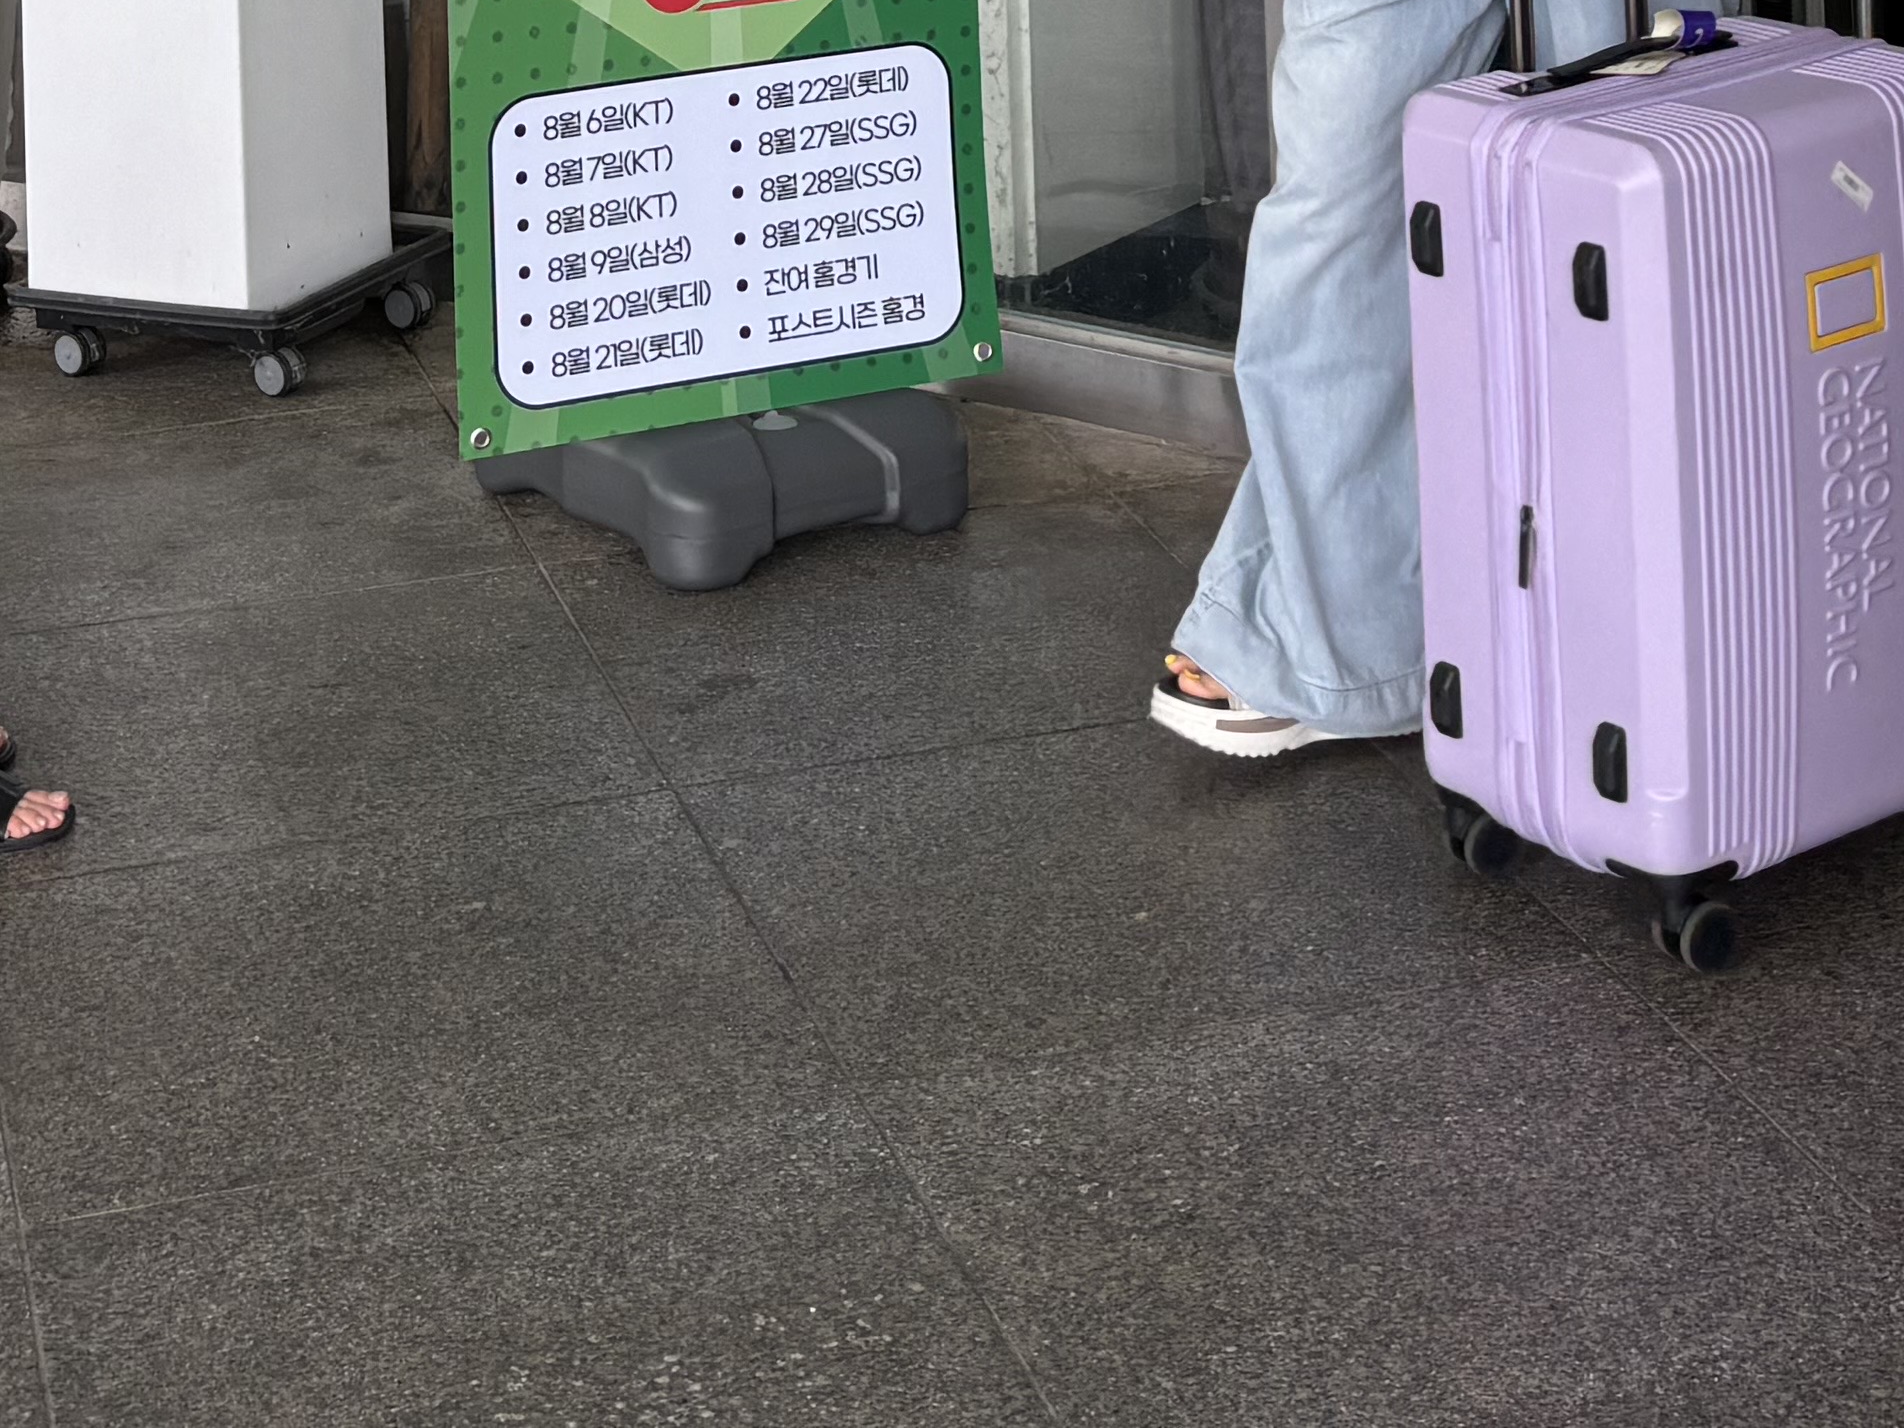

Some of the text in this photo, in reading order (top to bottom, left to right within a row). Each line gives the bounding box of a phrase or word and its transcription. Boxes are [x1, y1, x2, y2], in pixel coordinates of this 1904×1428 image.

[756, 65, 909, 111] 8월 22일(롯데)
[543, 97, 674, 141] 8월 6일(KT)
[758, 109, 918, 156] 8월 27일(SSG)
[545, 144, 674, 188] 8월 7일(KT)
[760, 155, 922, 202] 8월 28일(SSG)
[546, 190, 678, 235] 8월 8일(KT)
[762, 200, 925, 249] 8월 29일(SSG)
[547, 235, 692, 283] 8월 9일(삼성)
[764, 253, 879, 296] 잔여 홈경기
[549, 279, 712, 330] 8월 20일(롯데)
[767, 292, 926, 343] 포스트시즌 홈경
[551, 327, 704, 378] 8월 21일(롯데)
[1854, 355, 1896, 614] NATIONAL
[1816, 366, 1859, 693] GEOGRAPHIC
